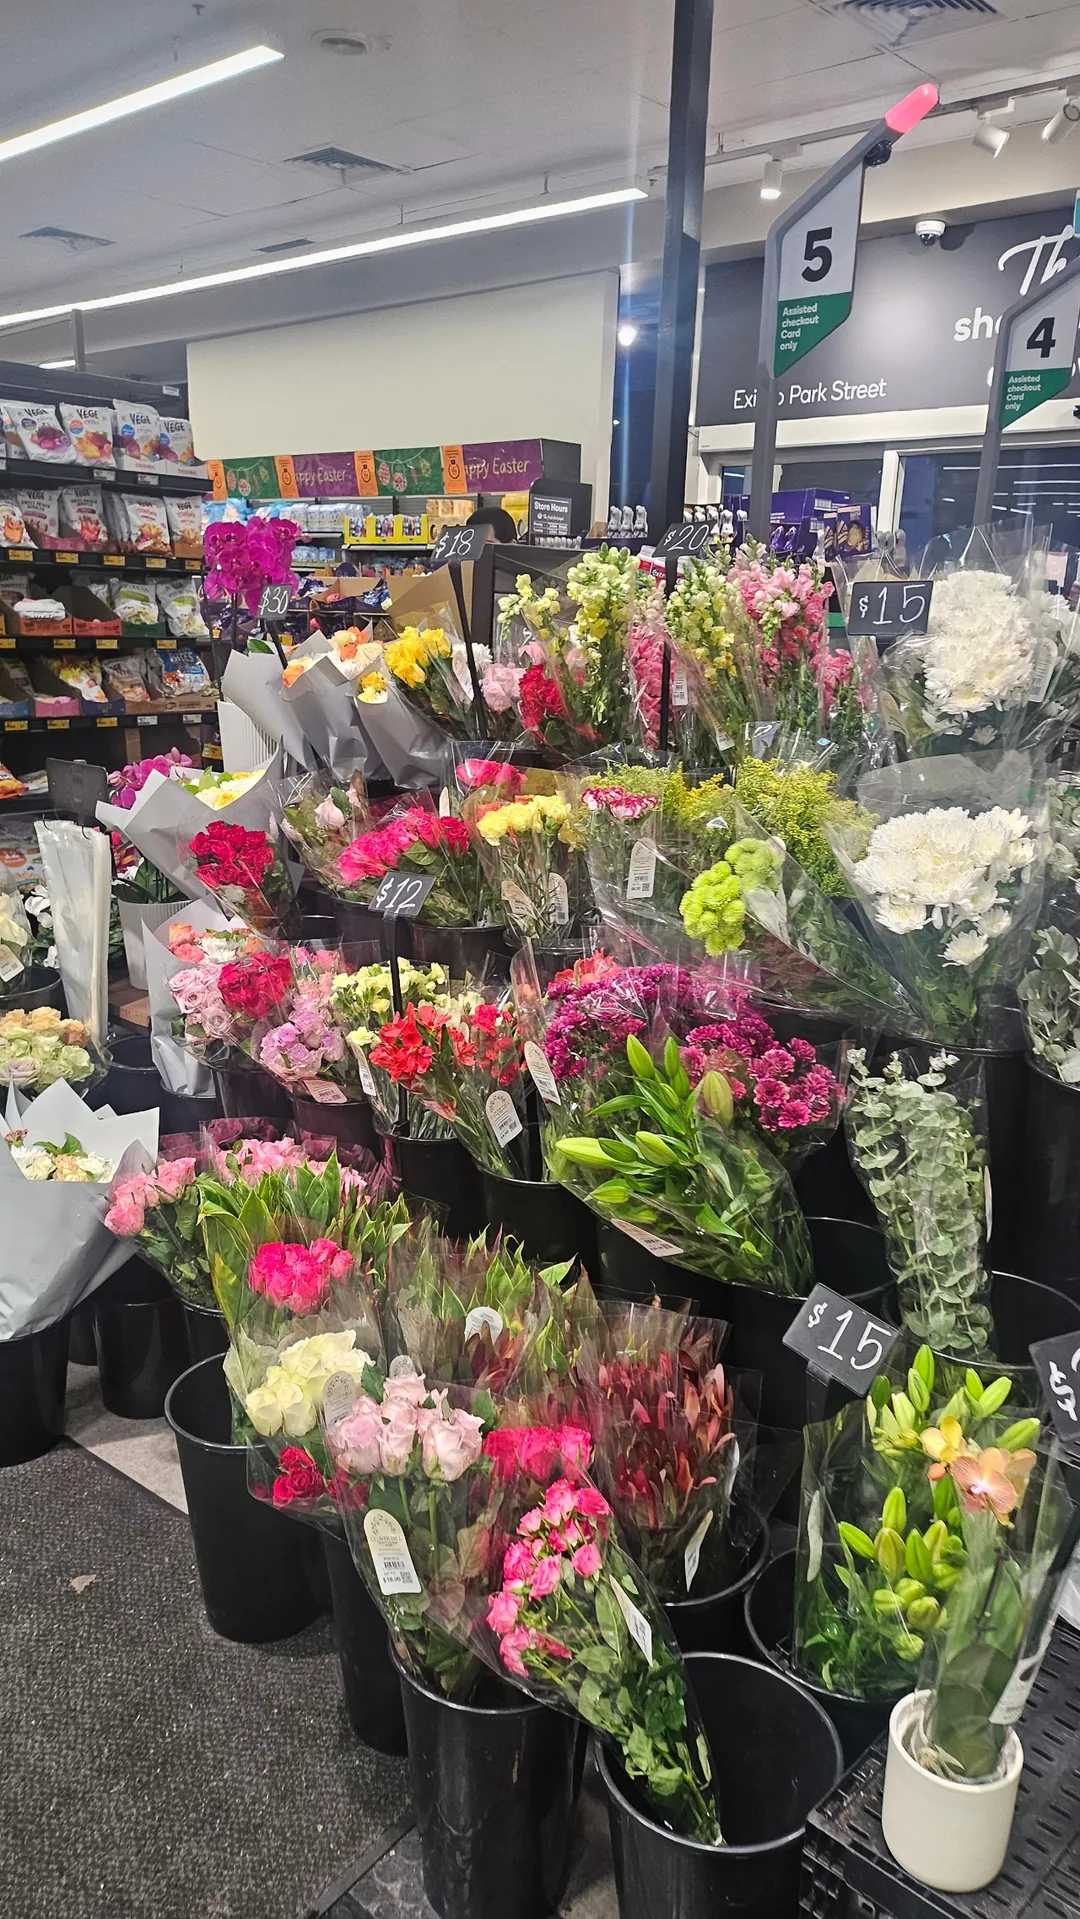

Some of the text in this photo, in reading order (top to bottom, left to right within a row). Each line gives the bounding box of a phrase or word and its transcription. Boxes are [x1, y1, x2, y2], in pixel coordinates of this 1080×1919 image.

[801, 227, 832, 282] 5
[998, 225, 1075, 296] Th
[783, 303, 818, 316] Assisted
[782, 315, 820, 328] checkout
[781, 328, 801, 339] Card
[1026, 317, 1056, 358] 4
[780, 341, 797, 352] only
[1008, 374, 1041, 384] Assisted
[733, 389, 758, 409] Exi
[789, 382, 828, 405] Park
[831, 378, 887, 401] Street
[1007, 384, 1041, 393] checkout
[1006, 393, 1024, 402] Card
[76, 409, 99, 420] VEGE
[1005, 402, 1021, 411] only
[130, 413, 152, 425] VEGE
[164, 422, 185, 433] VEGE
[294, 467, 347, 486] appy Easter
[464, 458, 530, 480] appy Easter
[534, 501, 568, 513] Store Hours
[435, 528, 475, 559] $18
[663, 524, 709, 551] $20
[258, 586, 289, 615] $30
[858, 584, 926, 625] $15
[376, 877, 423, 913] $12
[808, 1302, 892, 1370] $15
